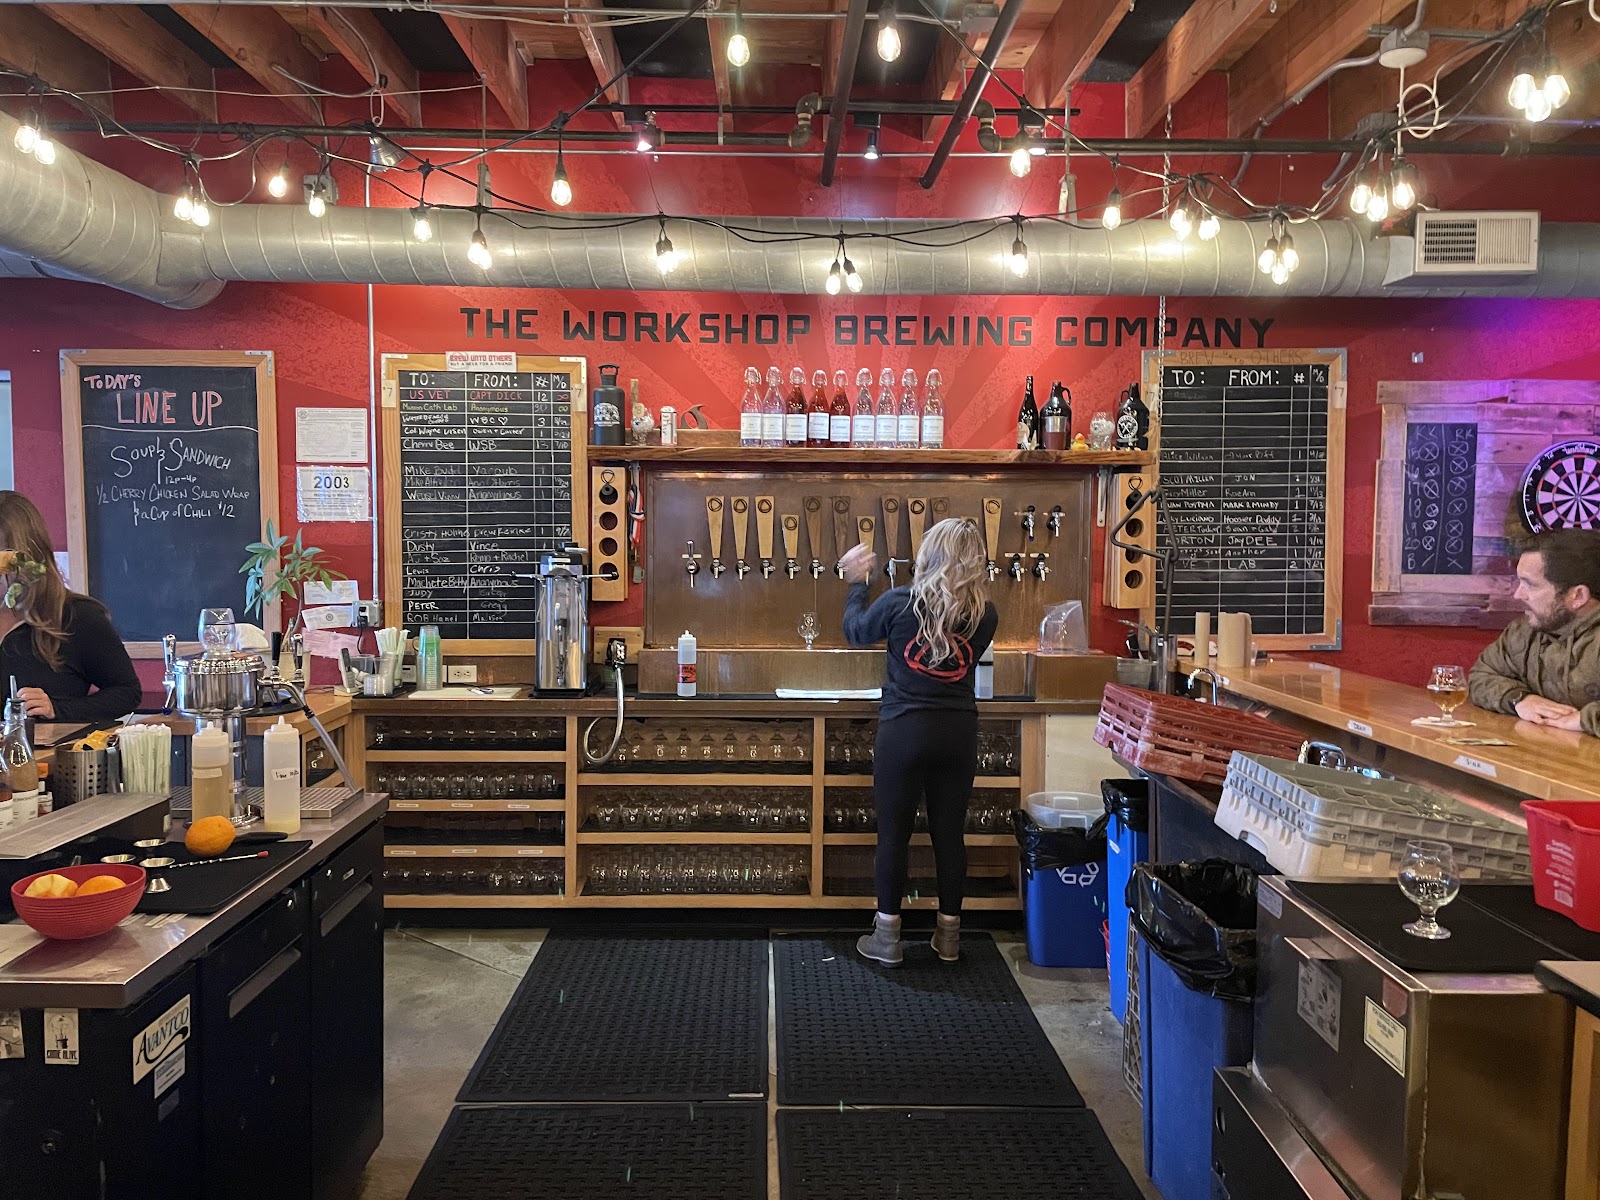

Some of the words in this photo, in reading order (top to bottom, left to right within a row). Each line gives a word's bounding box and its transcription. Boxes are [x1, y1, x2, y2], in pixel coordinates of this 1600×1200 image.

[460, 307, 539, 340] THE
[563, 310, 811, 345] WORKSHOP
[833, 314, 1032, 347] BREWING
[1054, 316, 1275, 348] COMPANY
[470, 354, 487, 362] UNTO
[488, 354, 513, 362] OTHERS
[409, 372, 435, 387] TO:
[474, 373, 518, 388] FROM:
[535, 375, 549, 388] #
[1171, 369, 1205, 386] TO:
[1228, 369, 1280, 386] FROM:
[1293, 372, 1305, 384] #
[409, 389, 424, 400] US
[428, 389, 451, 400] VET
[469, 390, 492, 401] CAPT
[496, 390, 523, 401] DICK
[116, 390, 177, 424] LINE
[191, 390, 223, 426] UP
[443, 403, 458, 411] Lab
[470, 403, 509, 413] Anonymous
[404, 465, 431, 476] Mike
[313, 476, 350, 489] 2003
[1234, 474, 1256, 482] JON
[1408, 481, 1422, 496] 17
[1222, 500, 1244, 509] MARK
[406, 540, 435, 555] Dusty
[469, 540, 499, 551] Vince
[406, 565, 430, 575] Lewis
[1227, 560, 1257, 570] LAB
[1289, 560, 1298, 569] 2
[408, 600, 440, 611] PETER
[406, 612, 429, 622] ROB
[135, 1006, 189, 1066] AVANTCO
